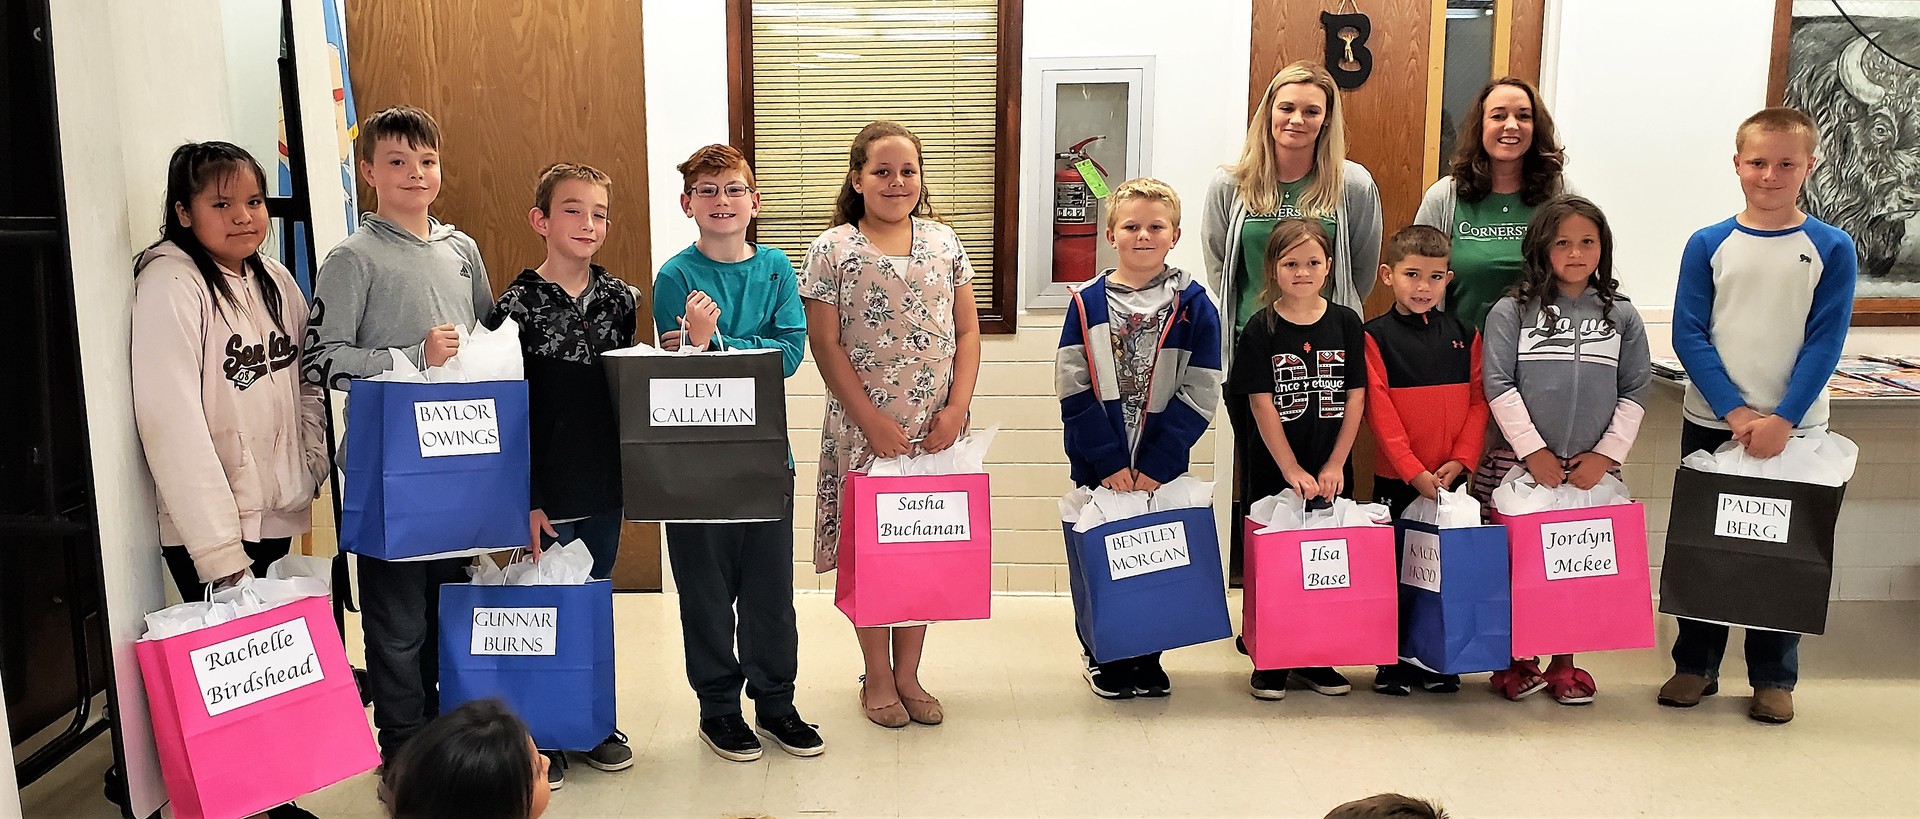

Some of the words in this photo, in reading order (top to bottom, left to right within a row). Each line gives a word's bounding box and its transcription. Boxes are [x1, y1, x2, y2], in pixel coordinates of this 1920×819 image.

[1320, 10, 1373, 89] B
[1459, 221, 1528, 237] CORNERST
[685, 383, 722, 398] LEVI
[1311, 376, 1345, 392] etique
[420, 404, 493, 422] BAYLOR
[652, 407, 753, 423] CALLAHAN
[422, 428, 498, 448] OWINGS
[898, 494, 945, 511] Sasha
[1722, 497, 1787, 518] PADEN
[880, 520, 966, 537] Buchanan
[1726, 520, 1778, 539] BERG
[1112, 526, 1177, 551] BENTLEY
[1545, 527, 1613, 550] Jordyn
[1112, 546, 1186, 572] MORGAN
[1309, 545, 1341, 562] Ilsa
[1553, 554, 1612, 574] Mckee
[1307, 572, 1347, 587] Base
[1409, 565, 1437, 583] HOOD
[475, 611, 555, 628] GUNNAR
[204, 629, 295, 671] Rachelle
[484, 636, 544, 653] BURNS
[206, 653, 315, 705] Birdshead
